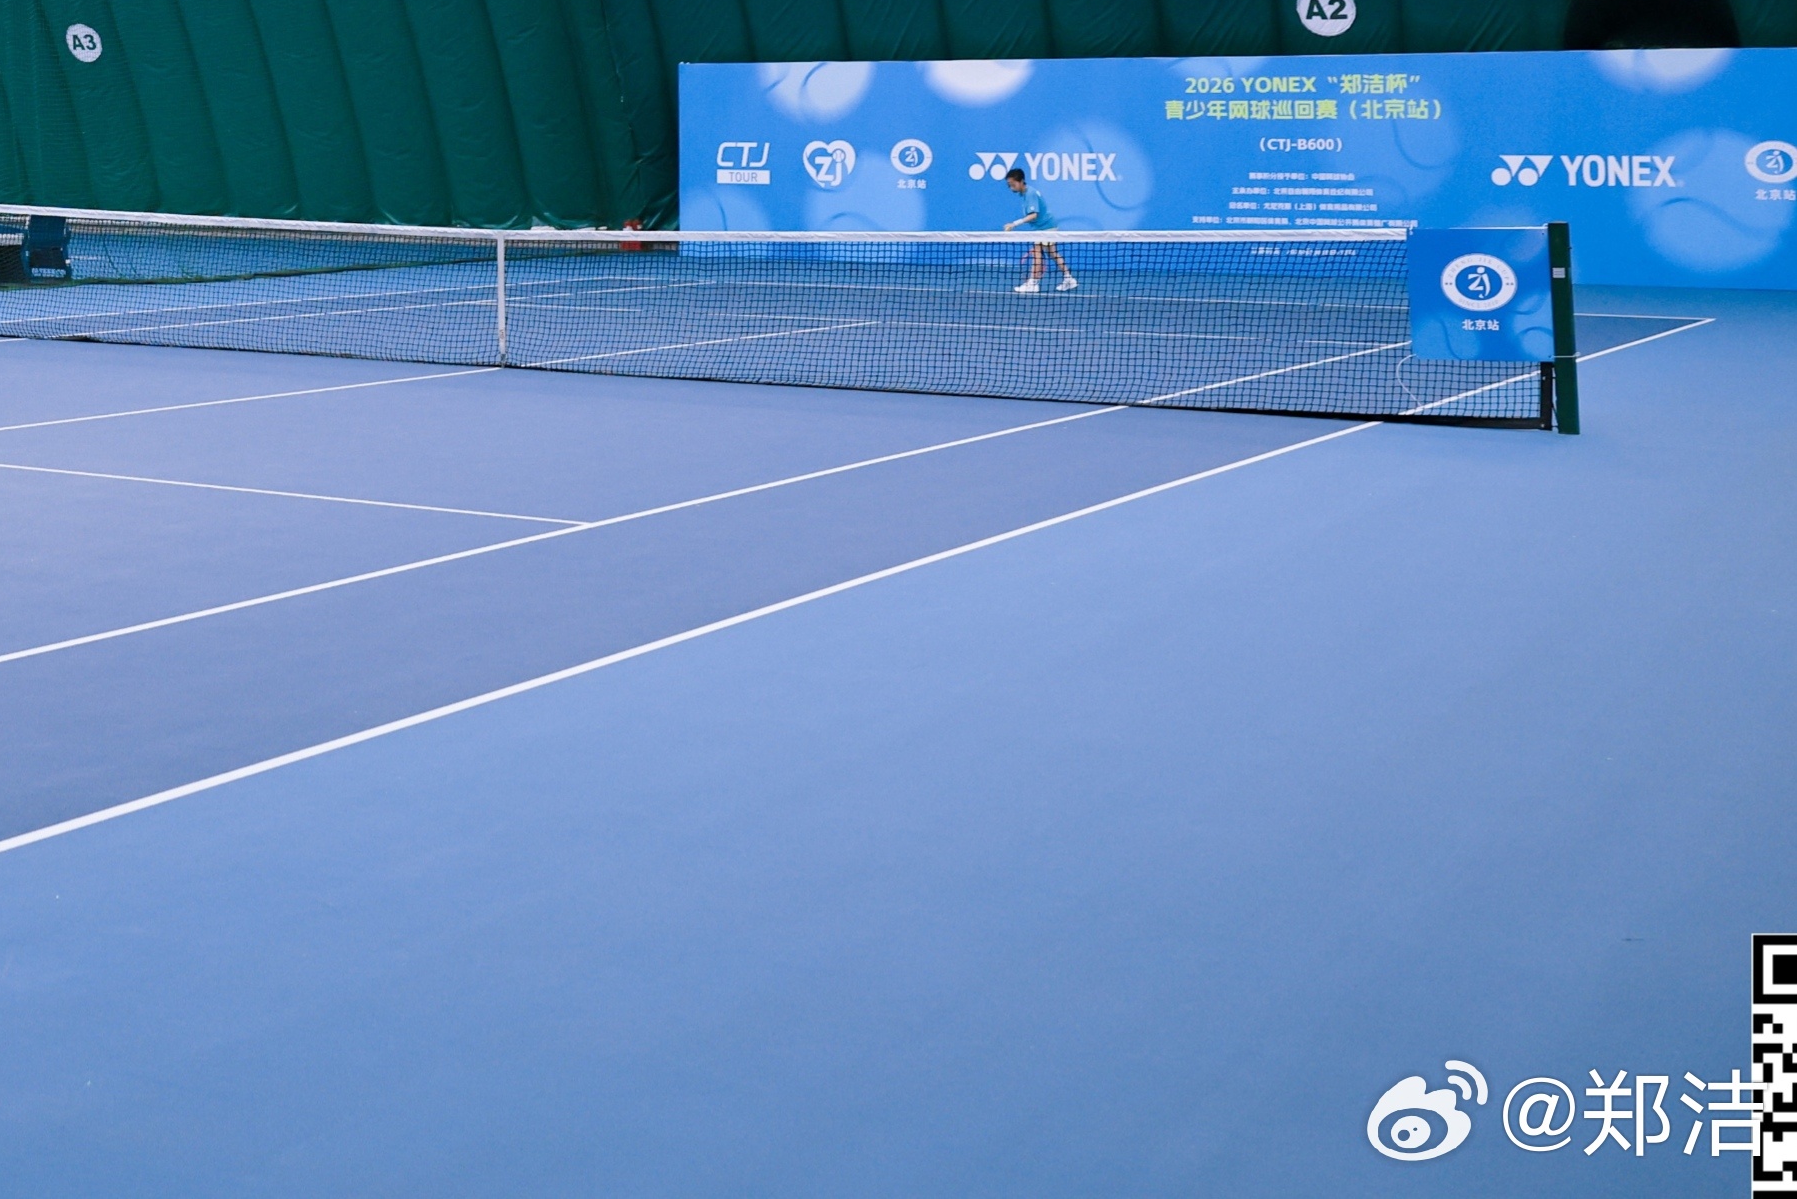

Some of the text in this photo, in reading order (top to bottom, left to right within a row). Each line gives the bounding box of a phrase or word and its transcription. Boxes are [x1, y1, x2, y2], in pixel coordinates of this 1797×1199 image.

[73, 34, 97, 51] A3
[1184, 77, 1235, 94] 2026
[1240, 76, 1317, 93] YONEX
[1164, 99, 1442, 121] 青少年网球巡回赛（北京站）
[716, 142, 771, 168] CTJ
[1024, 153, 1117, 182] YONEX
[1560, 154, 1677, 188] YONEX
[728, 172, 759, 183] TOUR
[897, 178, 928, 190] 北京站
[1755, 188, 1797, 201] 北京站
[1462, 319, 1500, 331] 北京站
